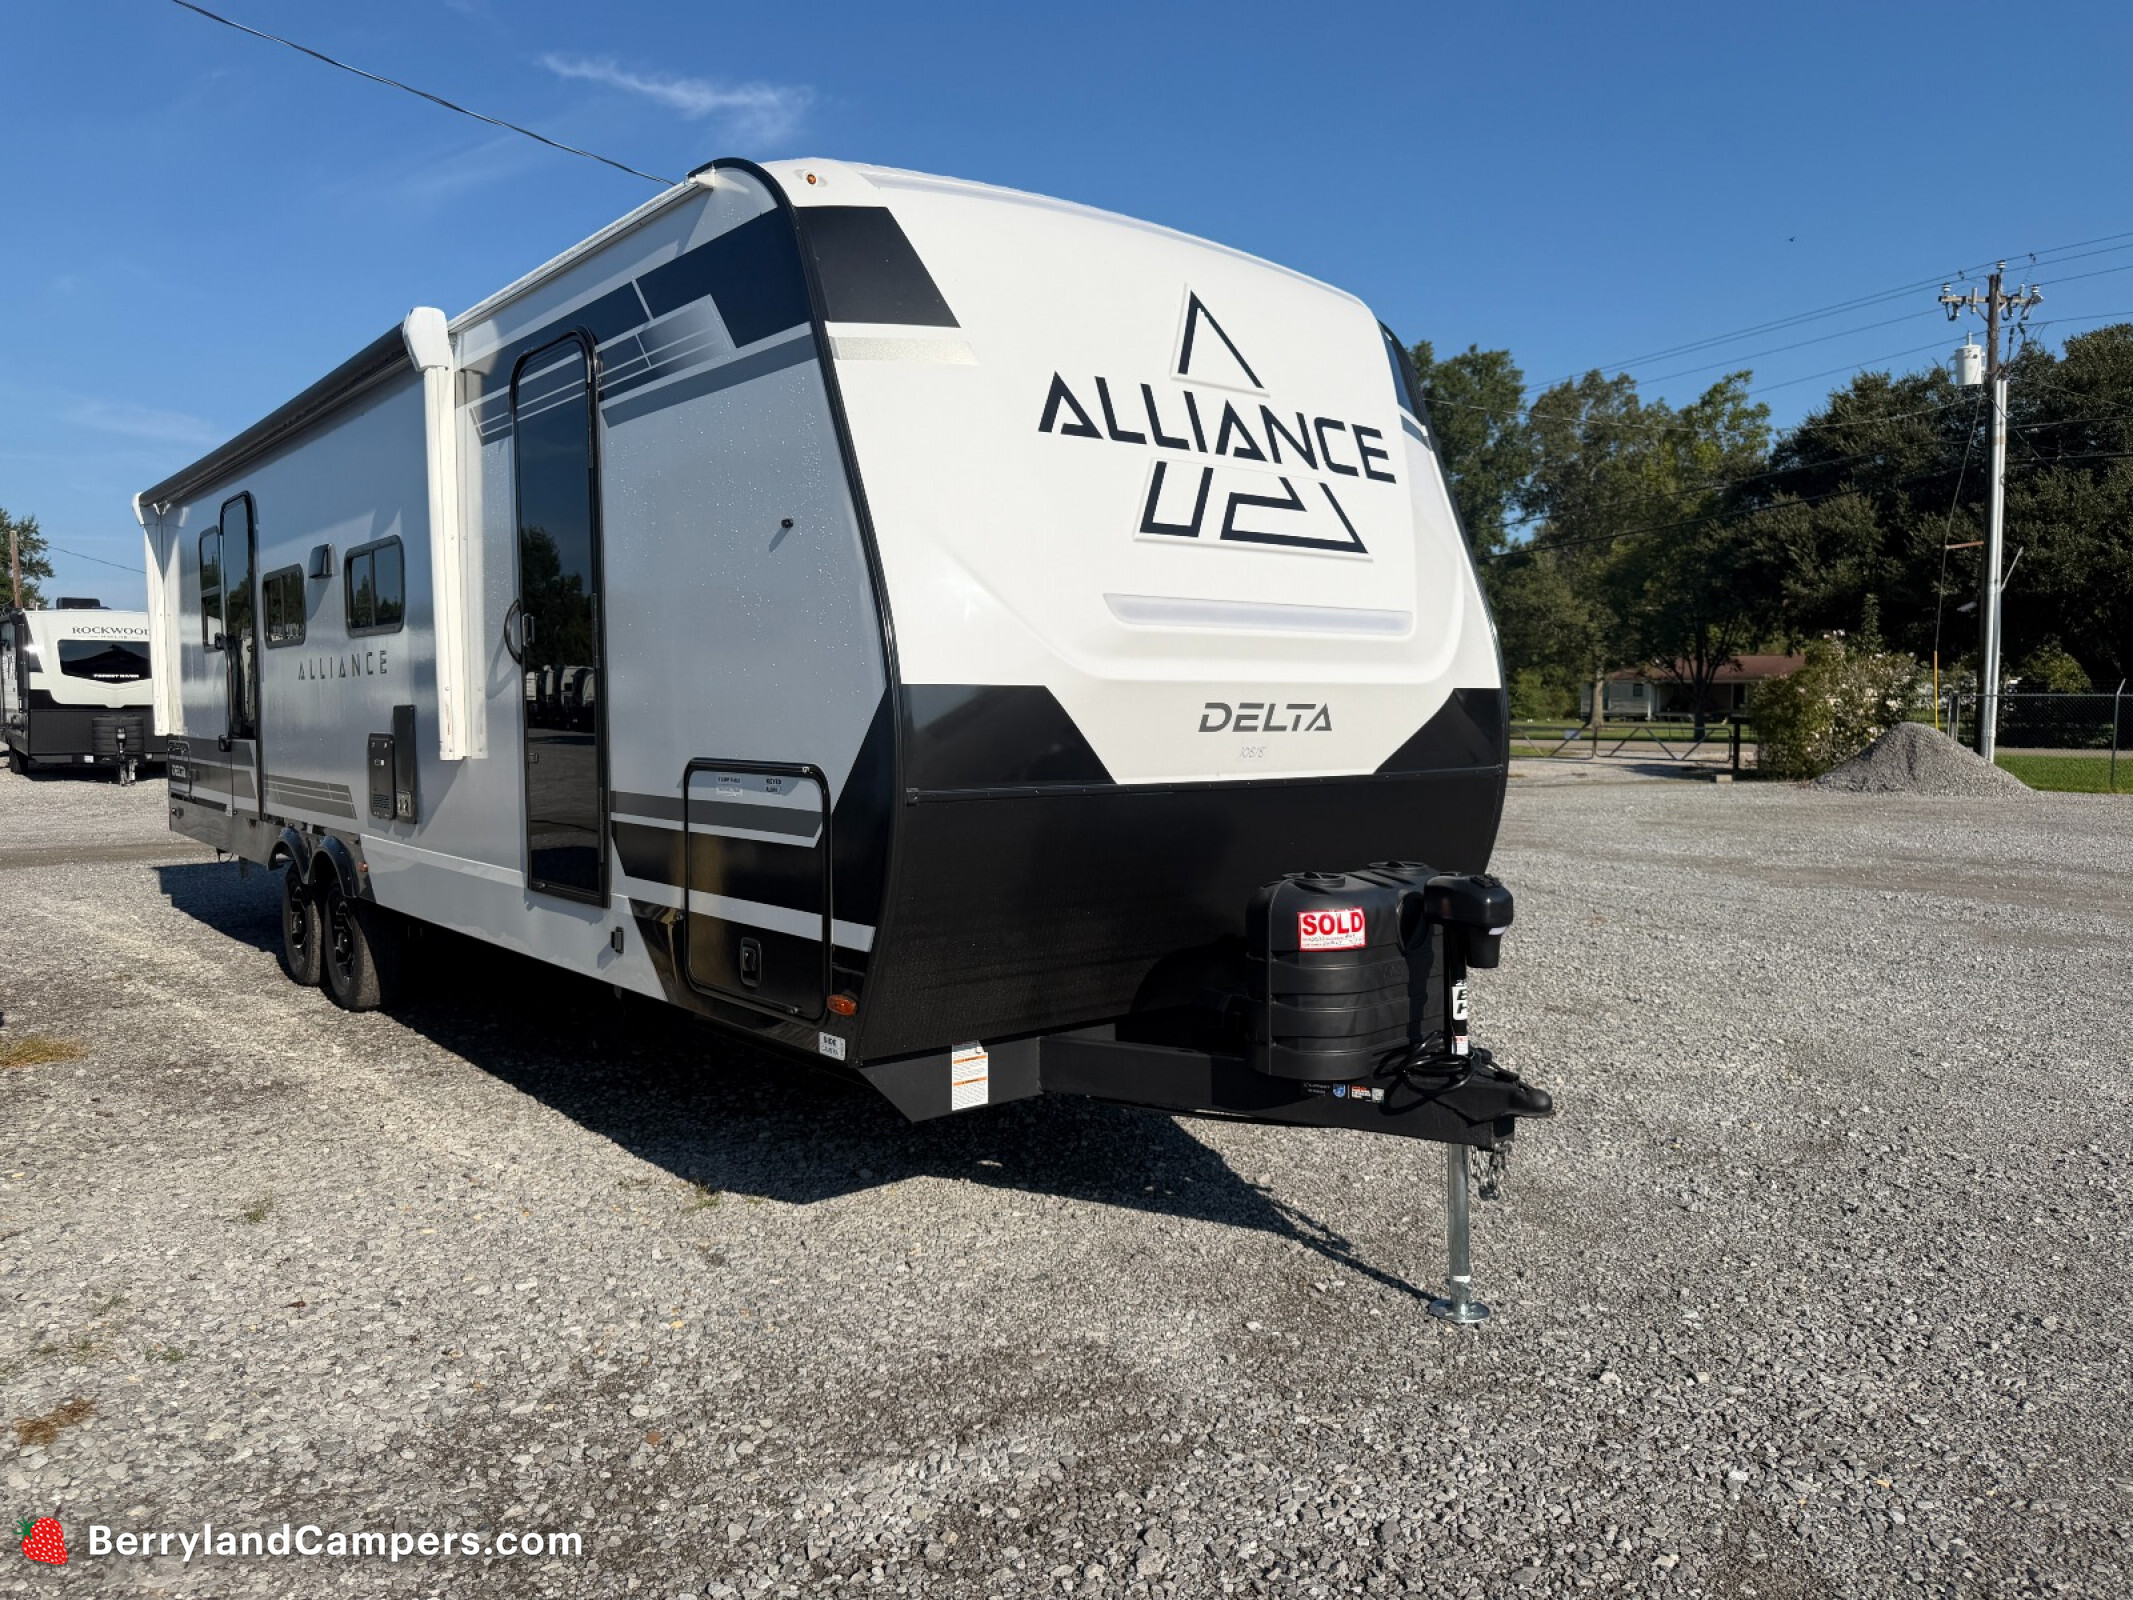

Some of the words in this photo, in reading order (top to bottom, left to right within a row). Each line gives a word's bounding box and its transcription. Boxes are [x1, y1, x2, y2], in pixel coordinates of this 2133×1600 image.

[1038, 370, 1396, 483] ALLIANCE
[298, 650, 388, 681] ALLIANCE
[1198, 702, 1333, 732] DELTA
[1302, 912, 1363, 936] SOLD
